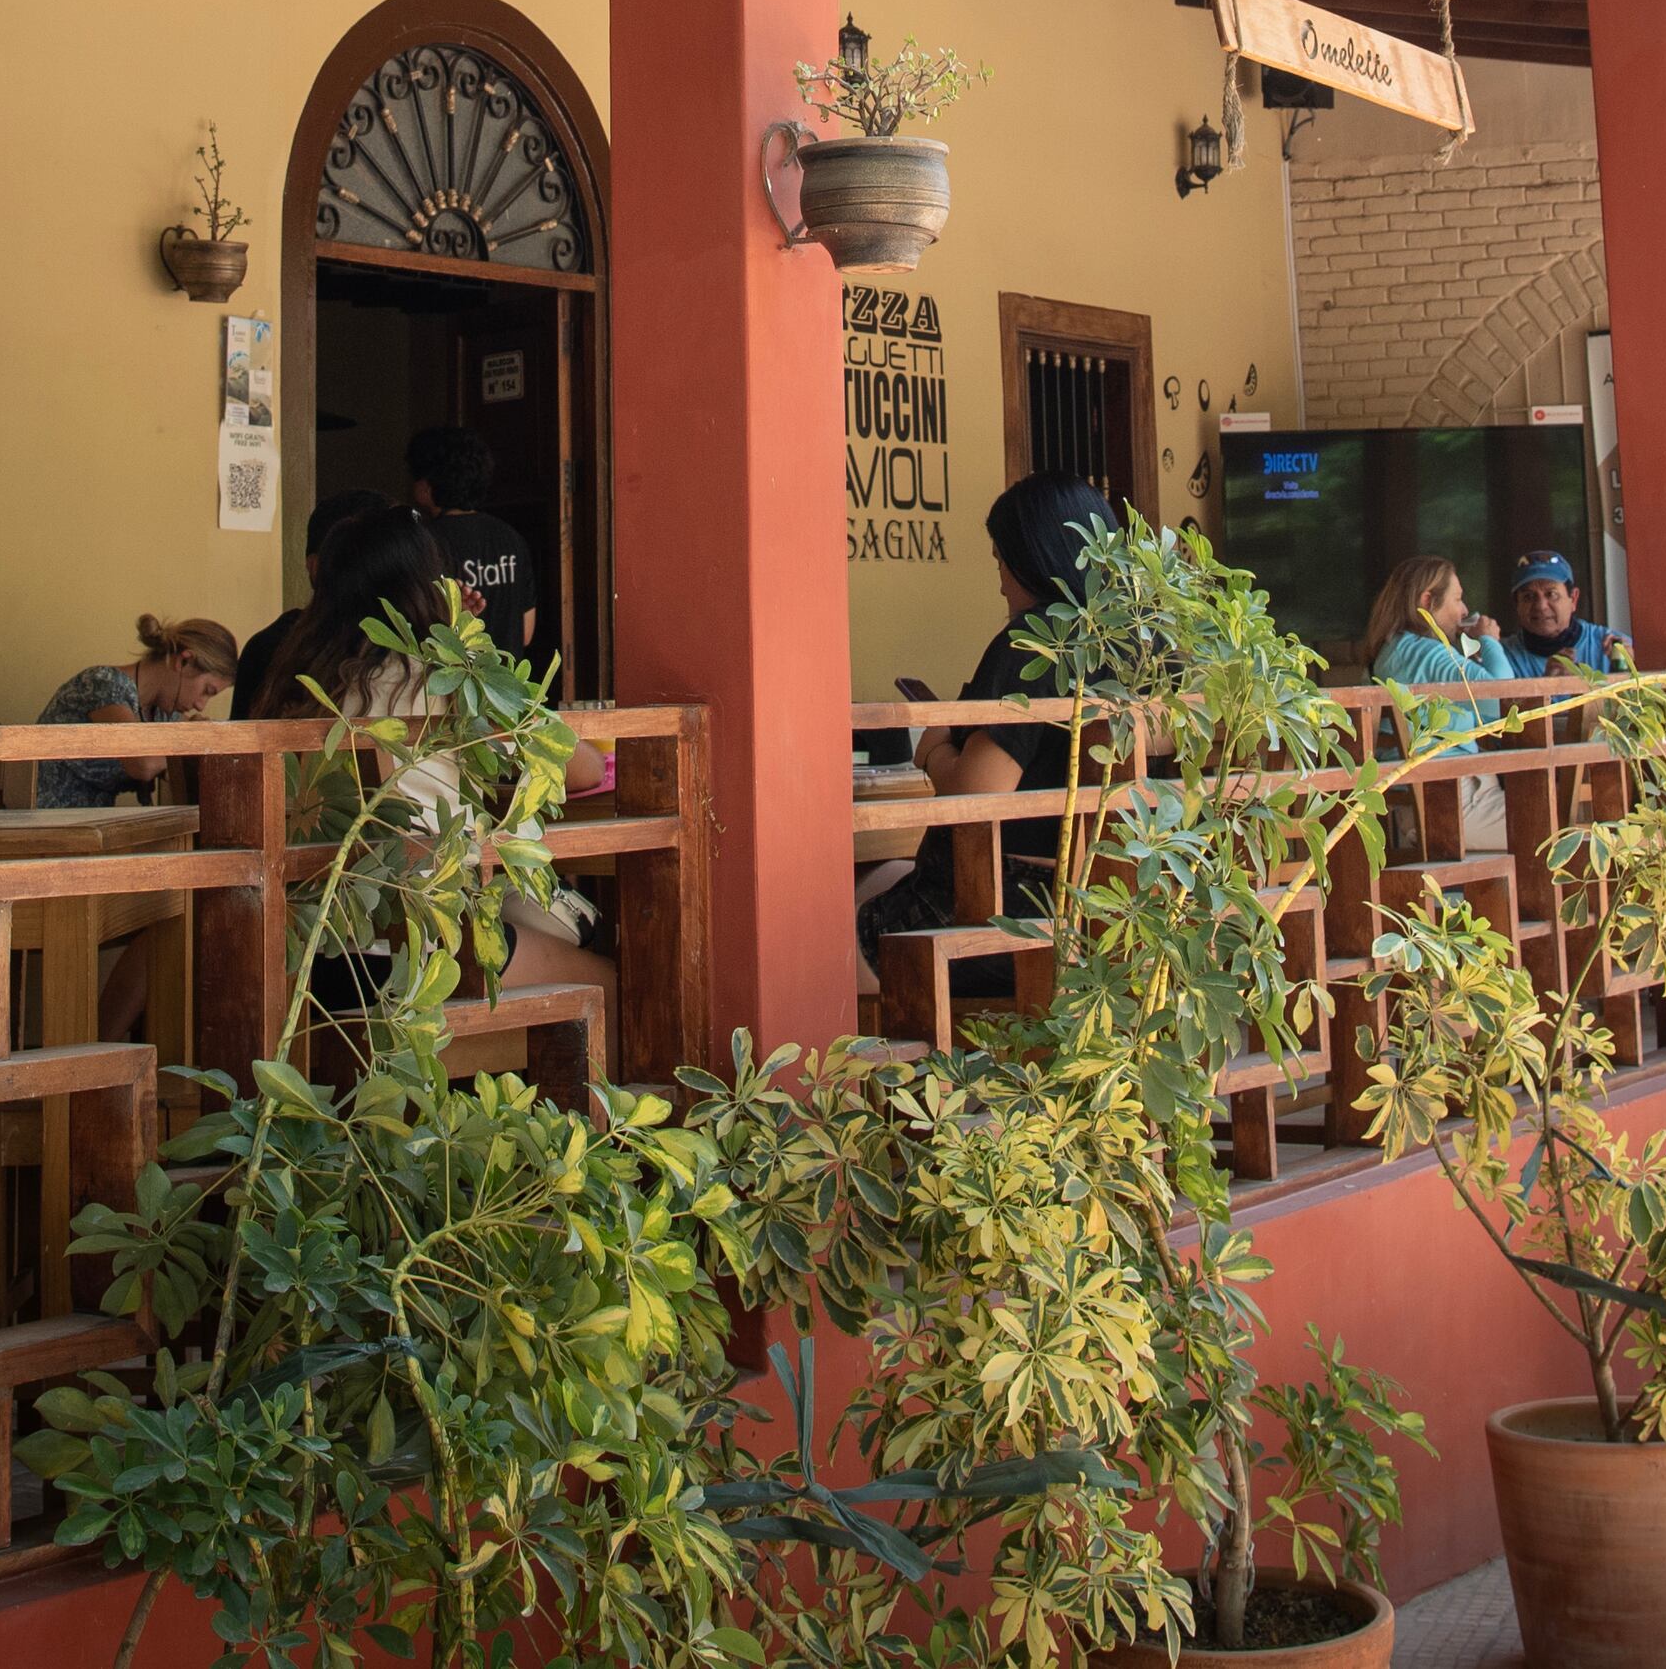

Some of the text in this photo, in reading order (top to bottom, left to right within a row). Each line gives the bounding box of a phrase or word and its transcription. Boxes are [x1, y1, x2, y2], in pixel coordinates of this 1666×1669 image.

[1300, 18, 1393, 87] Omelette
[842, 281, 943, 343] ZZA
[844, 336, 944, 375] GUETTI
[844, 368, 948, 444] TUCCINI
[1262, 451, 1319, 475] DIRECTV
[846, 517, 950, 563] SAGNA
[462, 554, 517, 589] Staff
